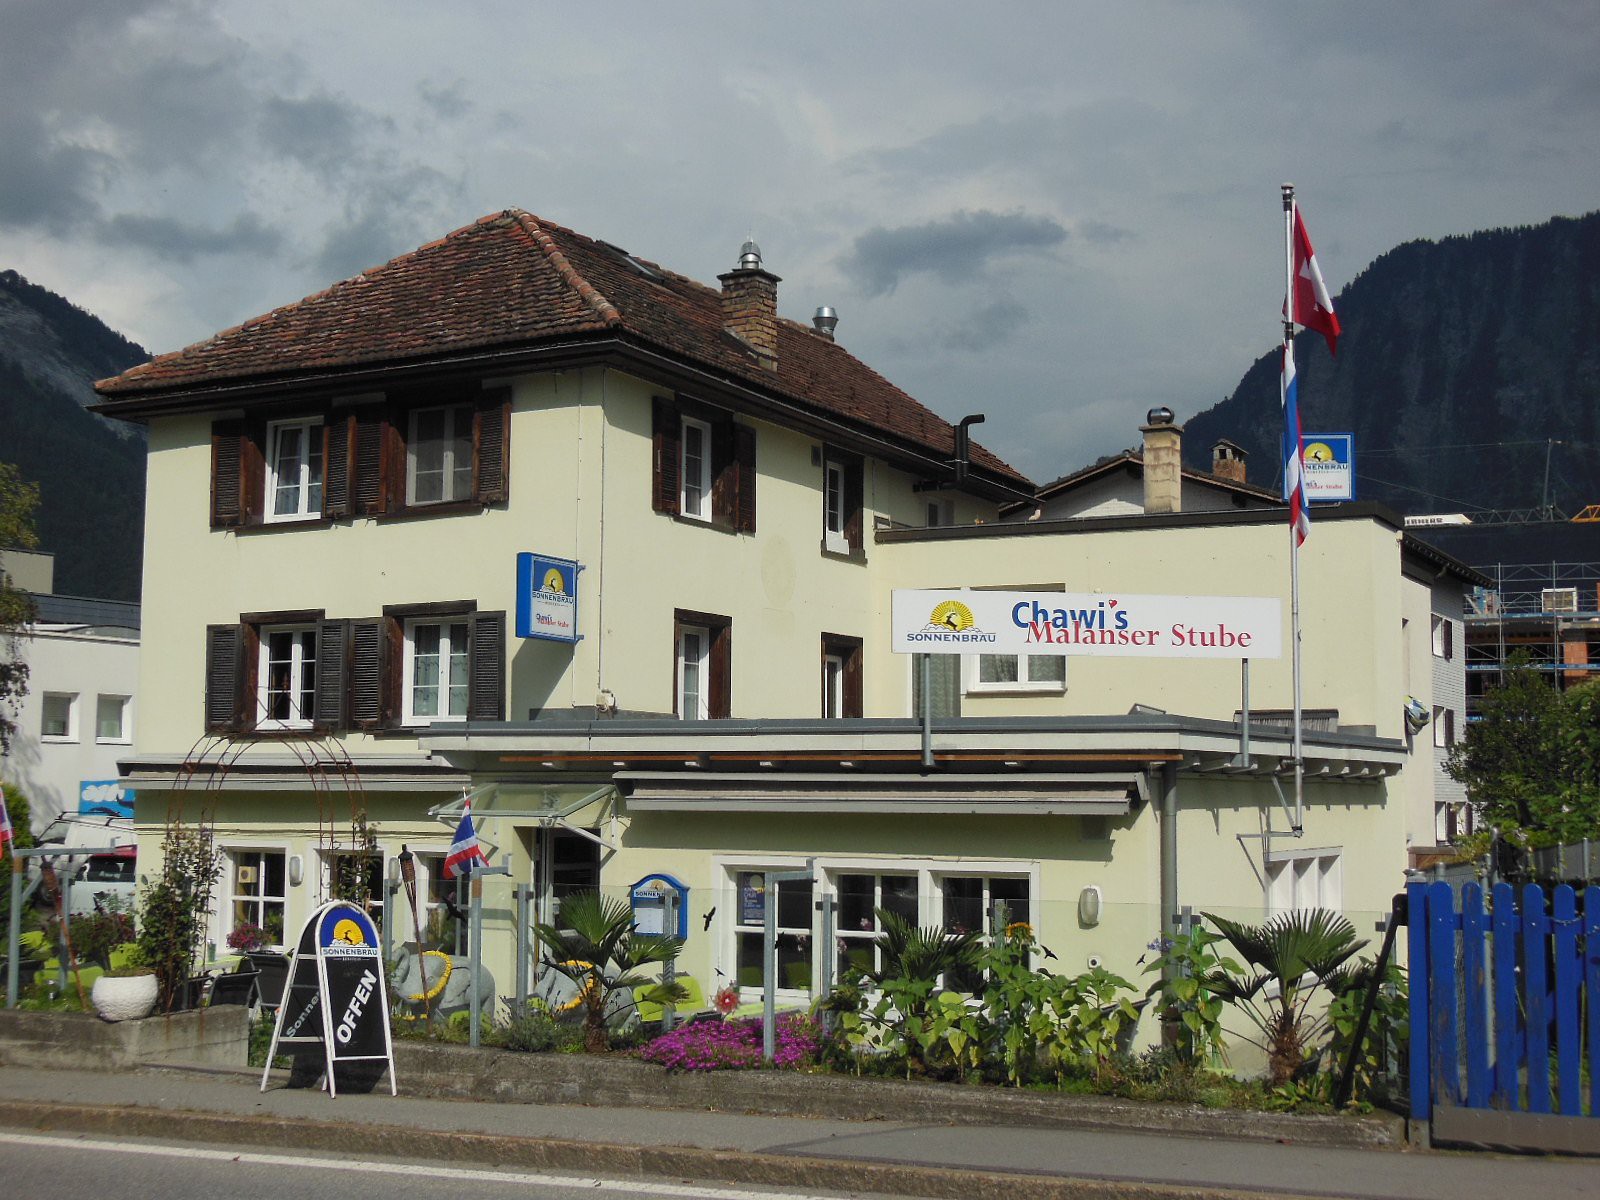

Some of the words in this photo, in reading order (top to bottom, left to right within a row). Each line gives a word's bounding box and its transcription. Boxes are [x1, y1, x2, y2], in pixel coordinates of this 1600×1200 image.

[1024, 620, 1160, 646] Malanser
[1171, 623, 1252, 648] Stube
[337, 969, 377, 1043] OFFEN
